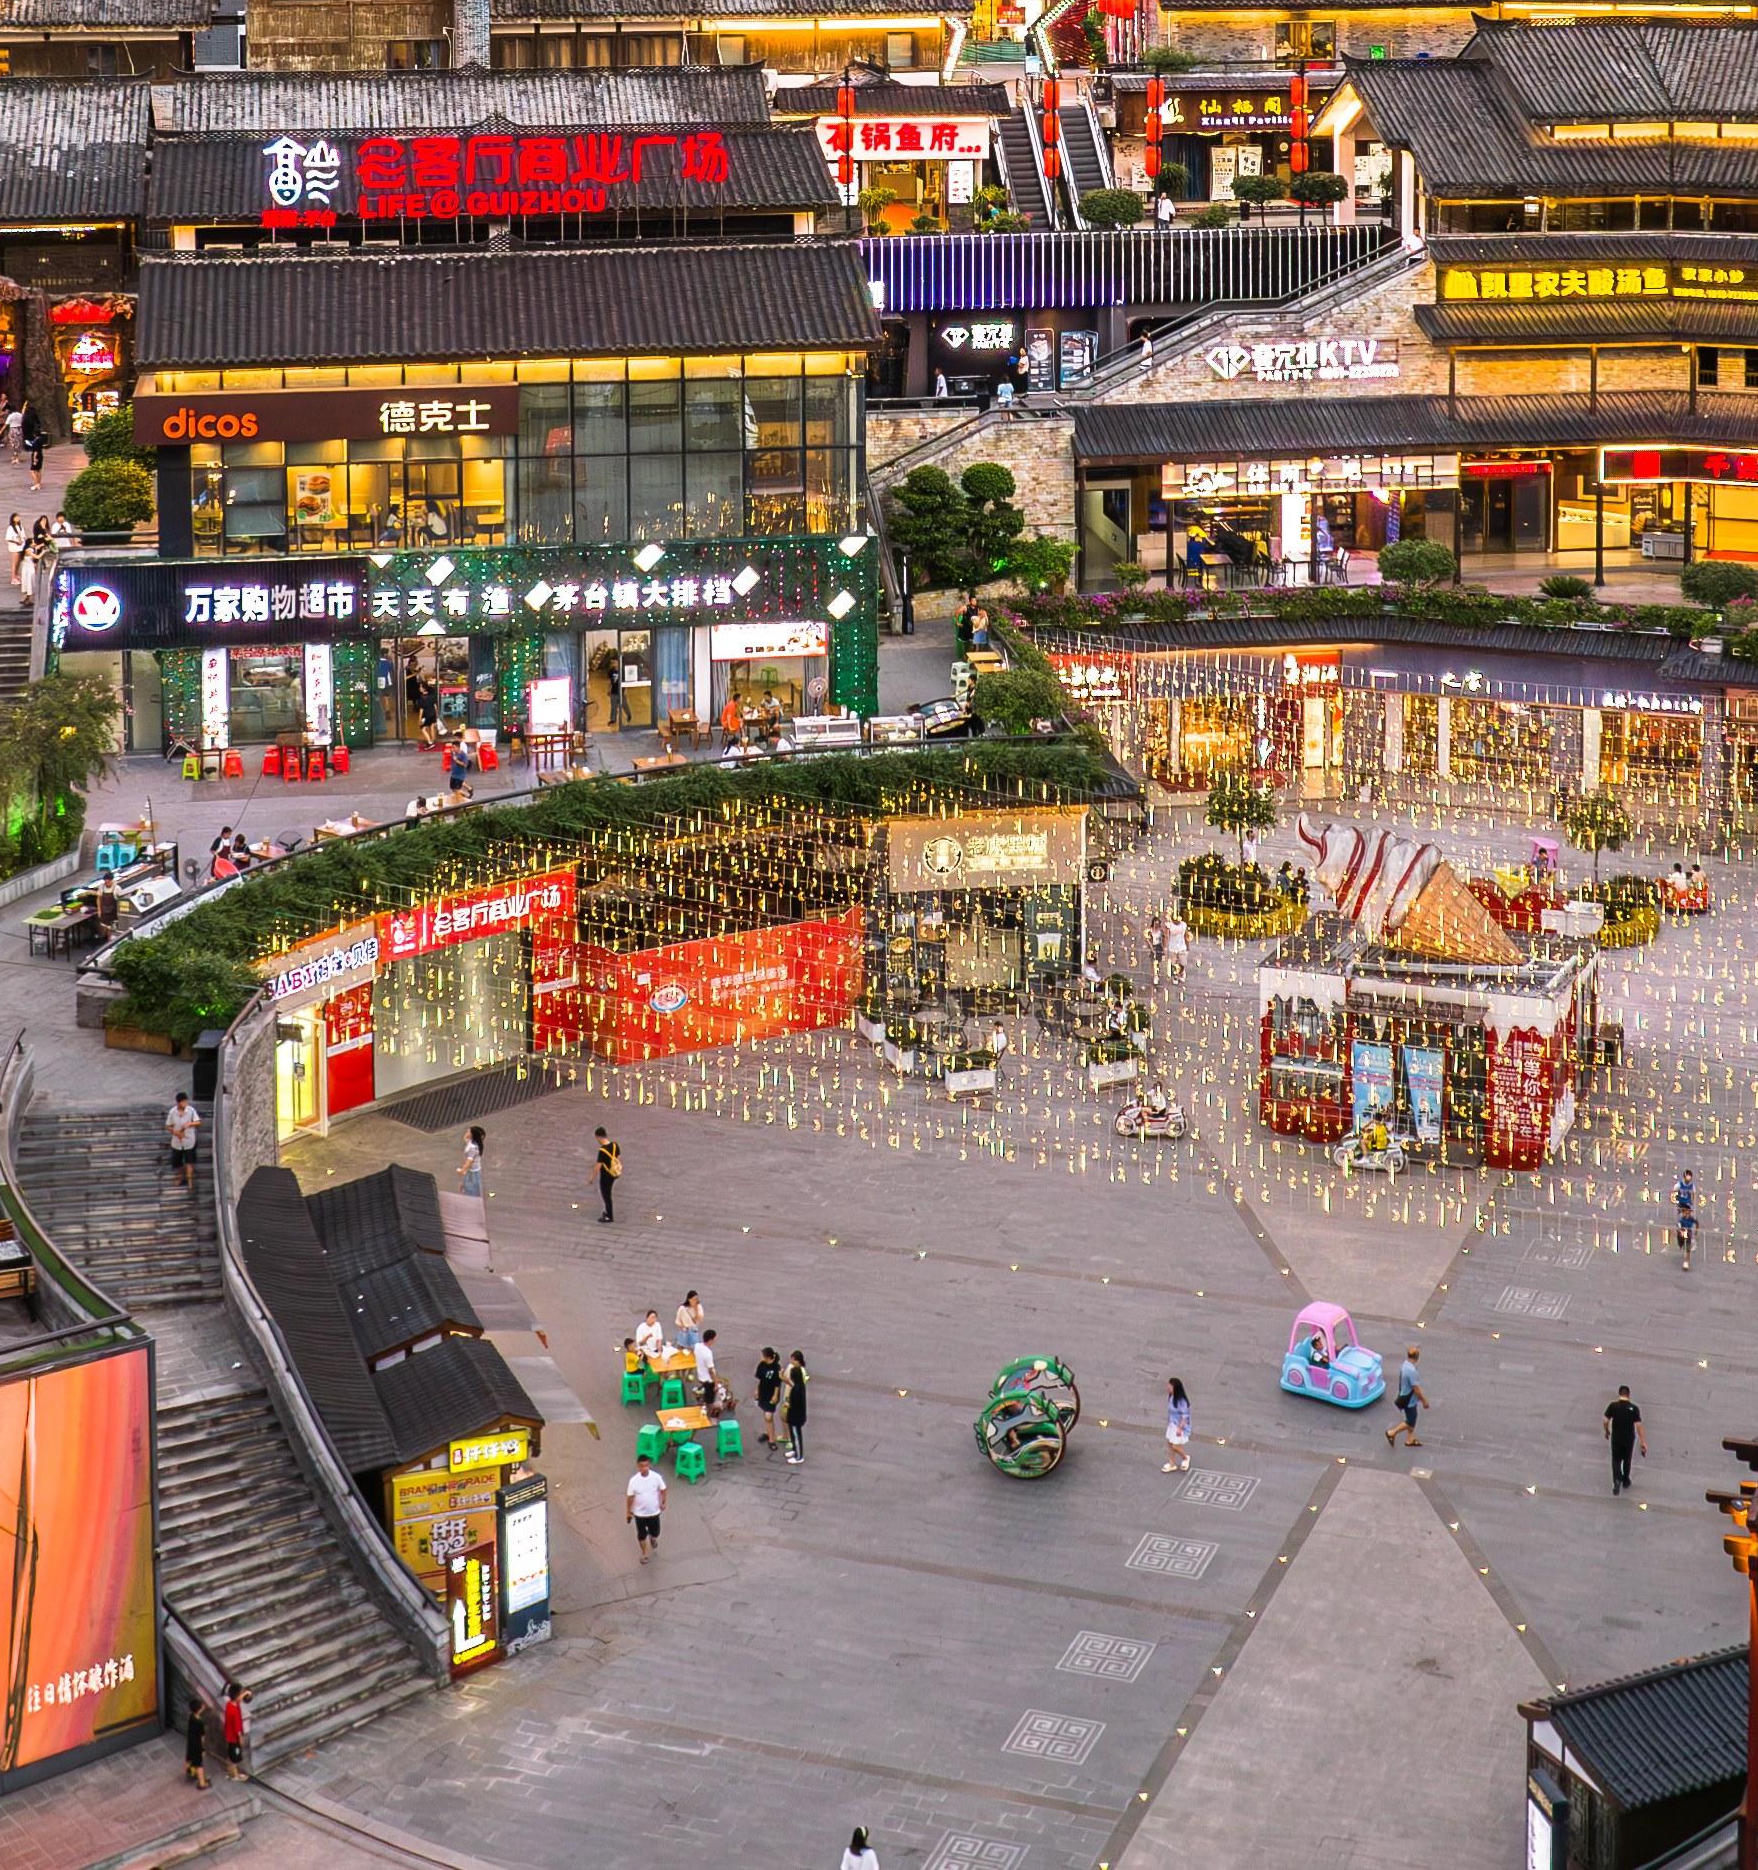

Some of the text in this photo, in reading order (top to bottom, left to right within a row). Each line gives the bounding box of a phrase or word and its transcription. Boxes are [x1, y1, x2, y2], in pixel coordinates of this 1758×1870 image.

[162, 407, 259, 439] dicos
[379, 399, 492, 433] 德克士
[185, 581, 355, 623] 万家购物超市
[552, 577, 734, 612] 茅台镇大排档
